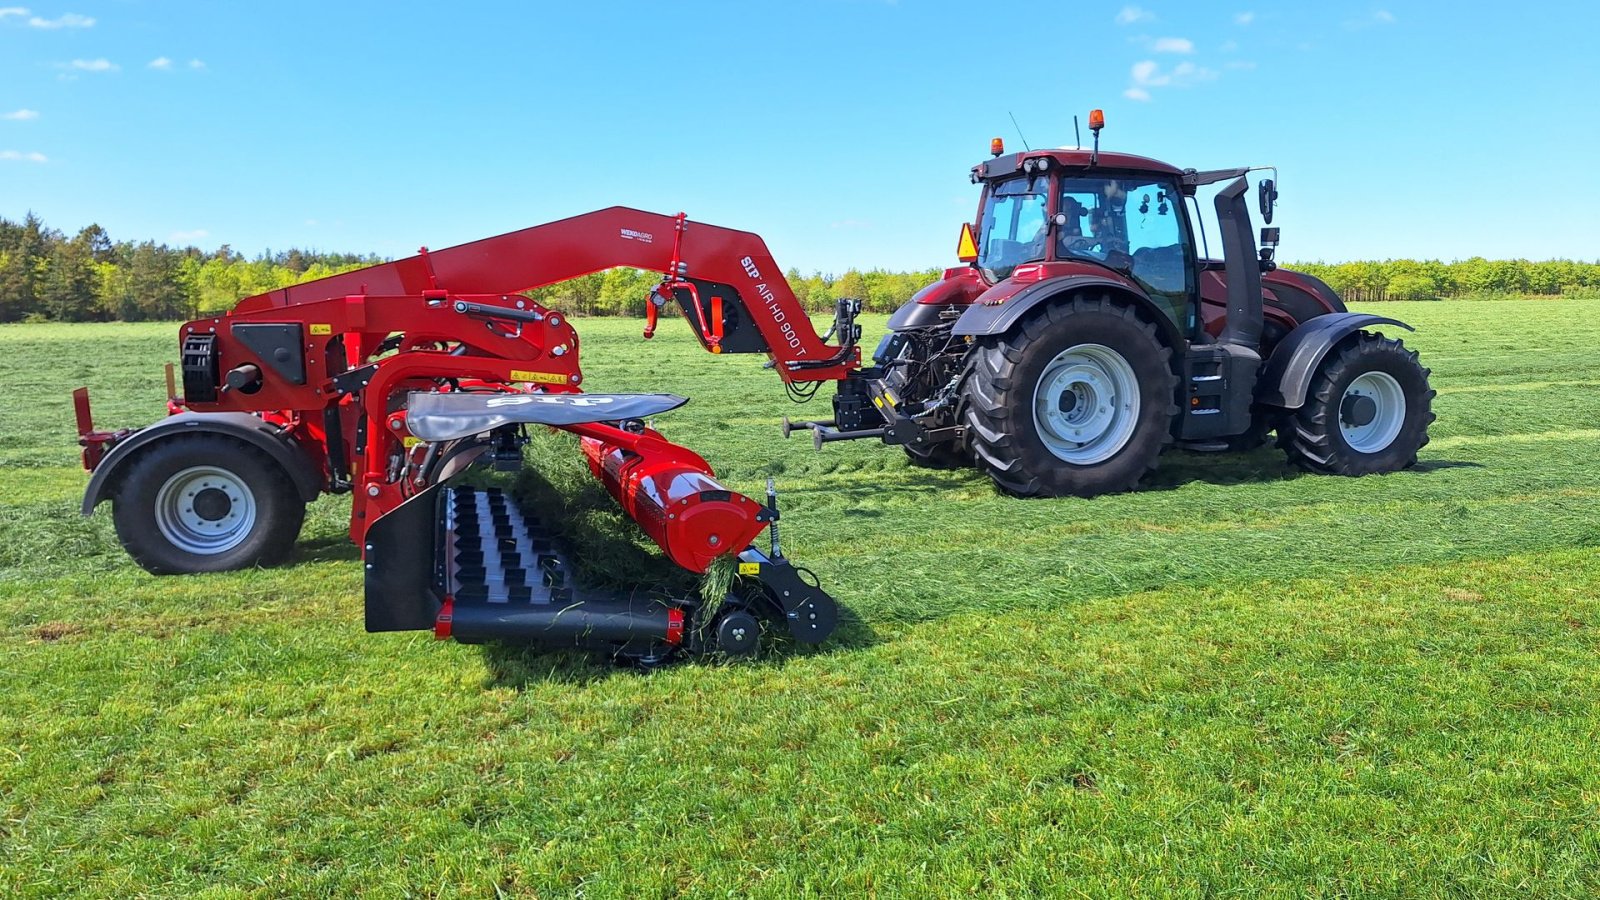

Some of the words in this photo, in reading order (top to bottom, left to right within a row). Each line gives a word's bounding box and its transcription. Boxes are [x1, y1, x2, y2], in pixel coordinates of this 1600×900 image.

[741, 256, 760, 278] SIP
[755, 283, 775, 305] AIR
[769, 303, 786, 323] HD
[780, 322, 800, 349] 900
[796, 347, 807, 356] T
[486, 396, 614, 408] SIP
